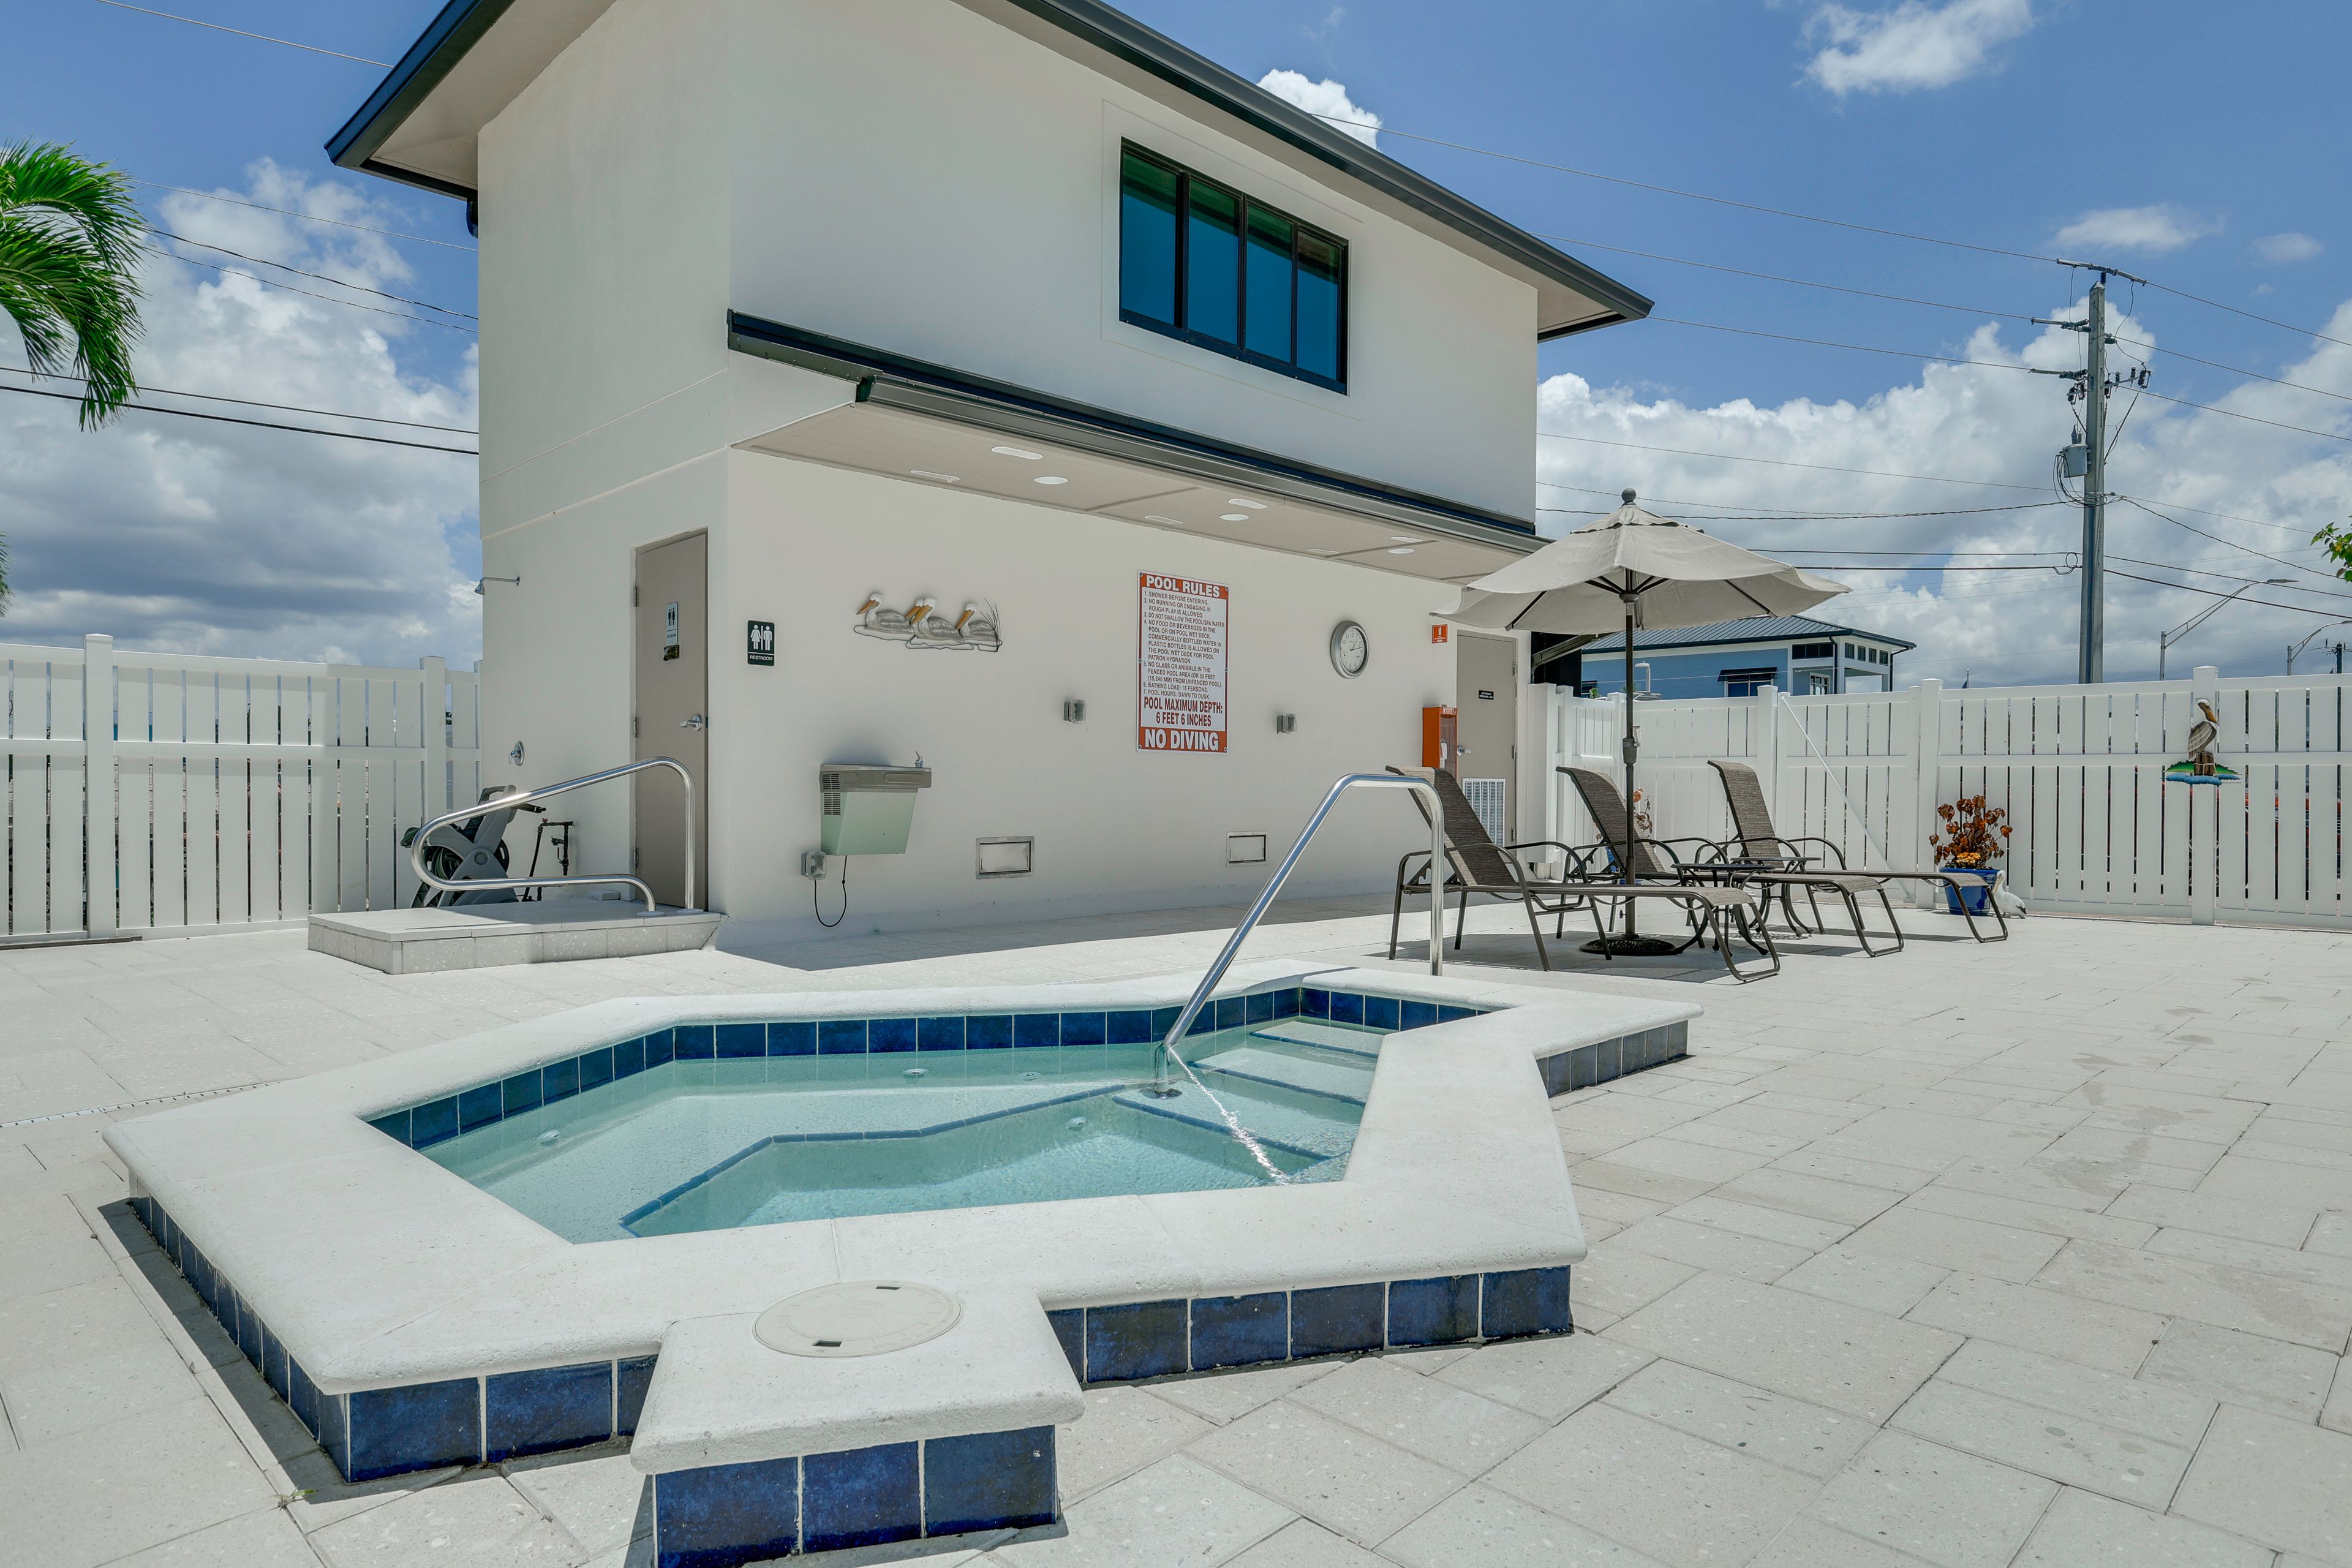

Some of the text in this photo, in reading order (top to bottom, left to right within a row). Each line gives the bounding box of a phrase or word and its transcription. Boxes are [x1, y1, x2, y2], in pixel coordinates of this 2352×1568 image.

[1147, 575, 1219, 598] POOL RULES
[1177, 623, 1202, 631] BEVERAGES
[1148, 633, 1182, 643] COMMERCIALLY
[1144, 696, 1223, 714] POOL MAXIMUM DEPTH:
[1156, 711, 1212, 726] 6 FEET 6 INCHES
[1145, 728, 1218, 751] NO DIVING
